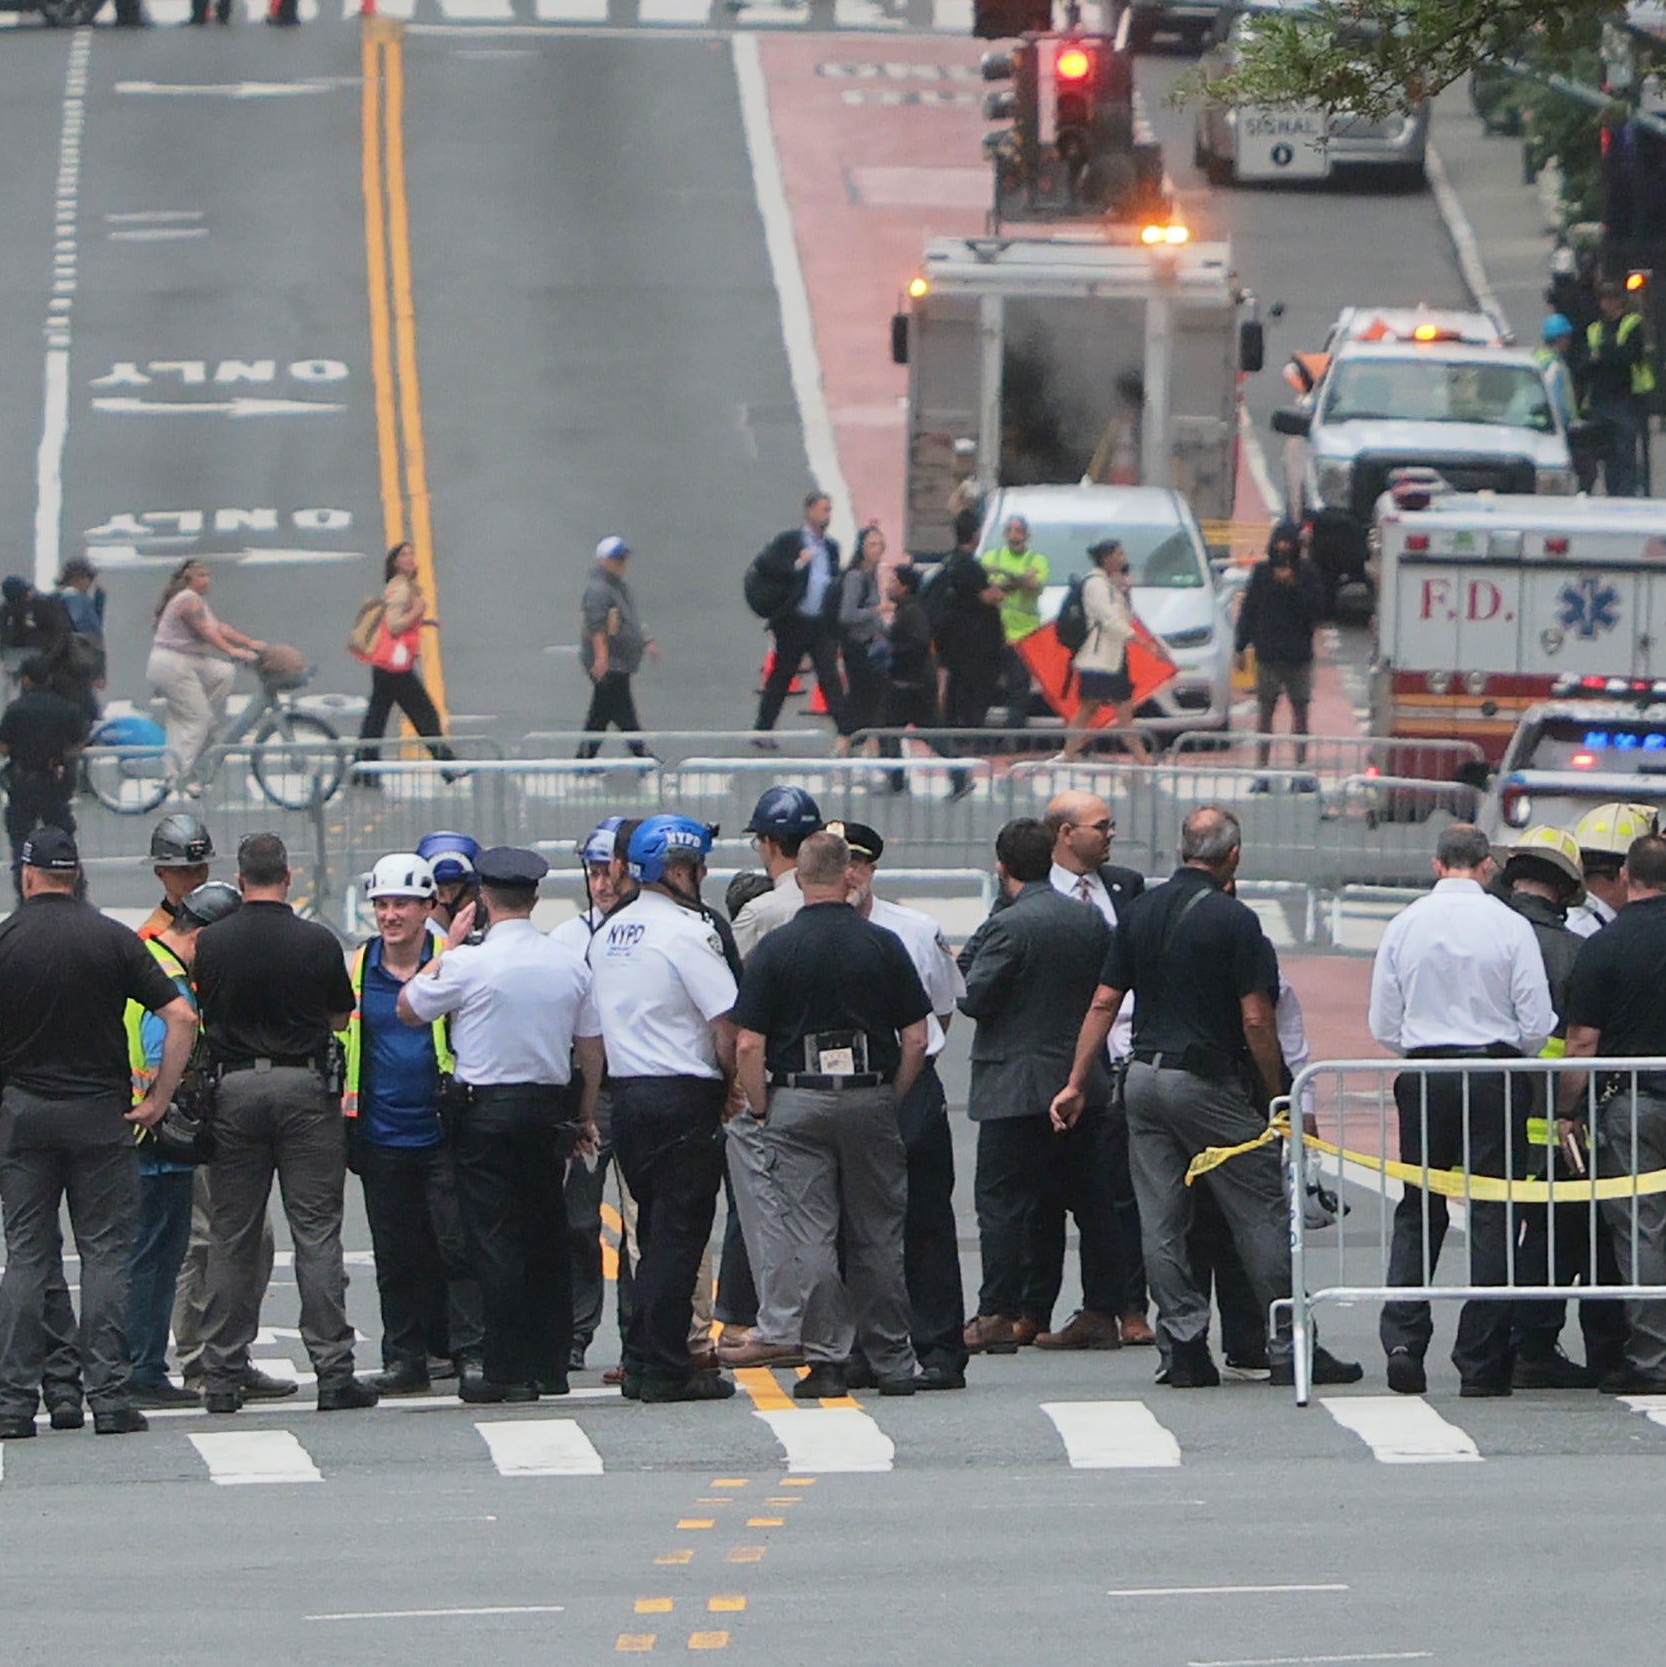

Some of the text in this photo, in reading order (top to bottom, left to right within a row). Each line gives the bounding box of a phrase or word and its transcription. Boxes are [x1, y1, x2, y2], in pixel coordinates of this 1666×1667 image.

[88, 359, 351, 387] ONLY
[1419, 578, 1516, 622] F.D.
[665, 831, 702, 848] NYPD
[606, 923, 646, 946] NYPD
